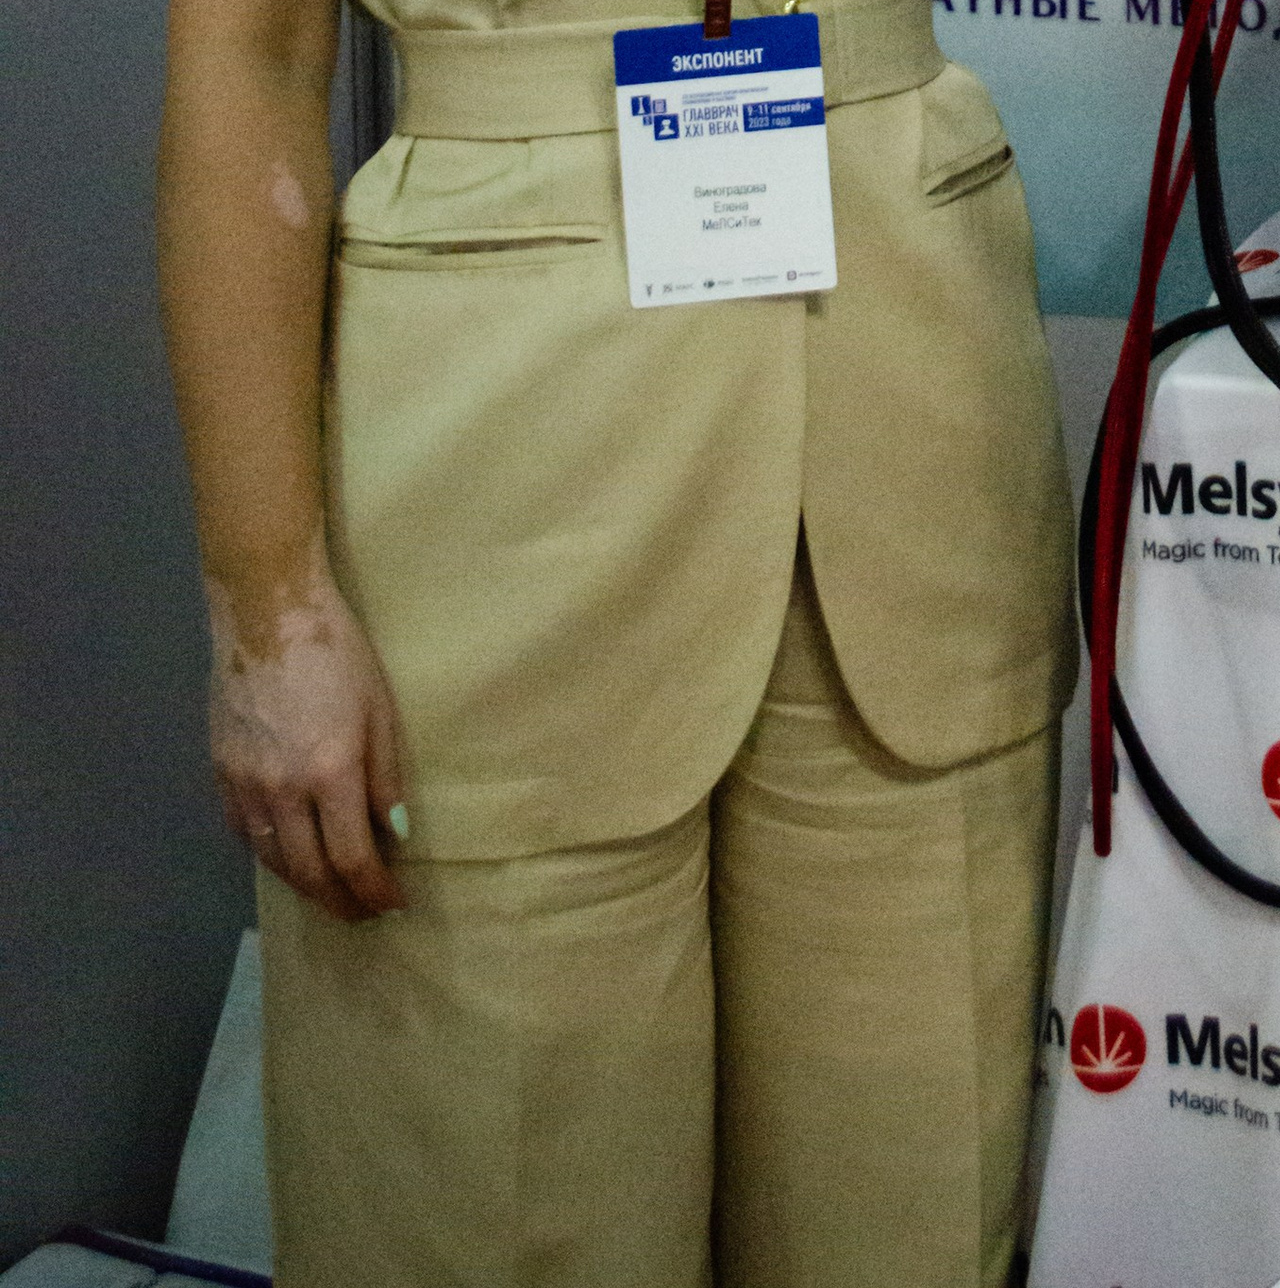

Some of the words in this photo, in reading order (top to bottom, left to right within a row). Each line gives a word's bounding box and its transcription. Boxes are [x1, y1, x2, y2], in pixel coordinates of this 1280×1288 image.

[672, 48, 763, 72] ЭКСПОНЕНТ
[683, 105, 739, 122] ГЛАВВРАЧ
[708, 121, 740, 136] ВЕКА
[1142, 539, 1205, 563] Magic
[1213, 537, 1260, 563] from
[1169, 1089, 1228, 1118] Magic
[1233, 1098, 1269, 1129] from
